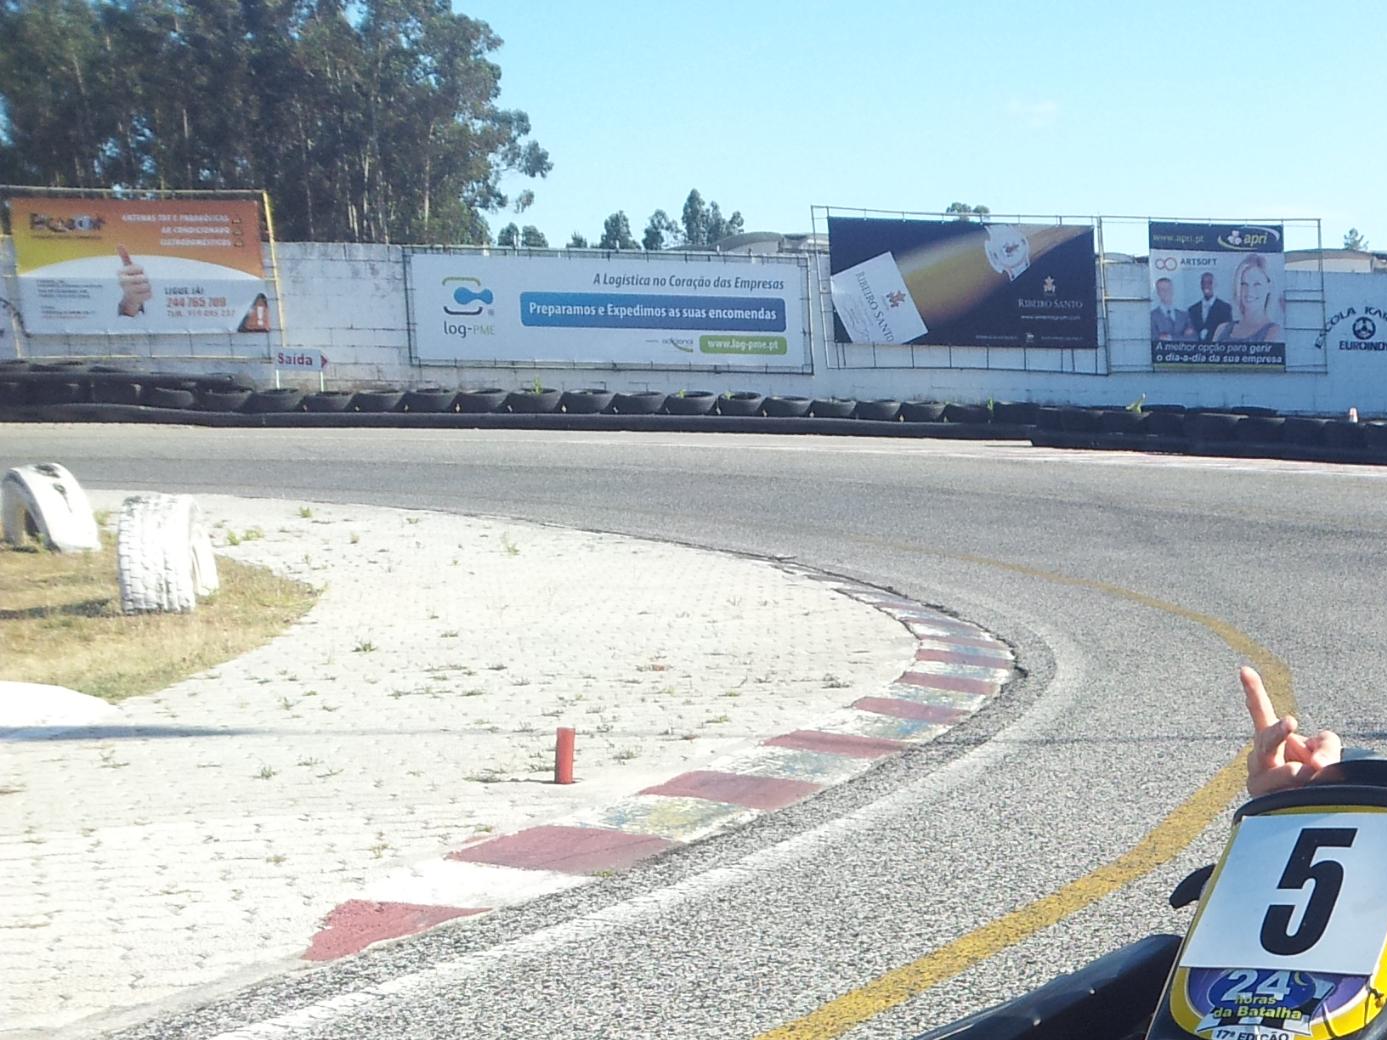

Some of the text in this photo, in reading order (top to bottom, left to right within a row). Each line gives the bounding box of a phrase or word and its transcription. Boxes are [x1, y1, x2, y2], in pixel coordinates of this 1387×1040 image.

[1243, 232, 1268, 246] apri
[1180, 257, 1217, 266] ARTSOFT
[593, 273, 785, 291] A Logística no Coração das Empresas
[529, 302, 777, 320] Preparamos e Expedimos as suas encomendas
[443, 320, 495, 339] log-PME
[1156, 341, 1273, 355] A melhor opção para gerir
[278, 352, 313, 366] Saída
[1156, 352, 1283, 365] o dia-a-dia da sua empresa
[1259, 828, 1359, 956] 5
[1221, 968, 1292, 1001] 24
[1213, 1005, 1303, 1020] da Batalha
